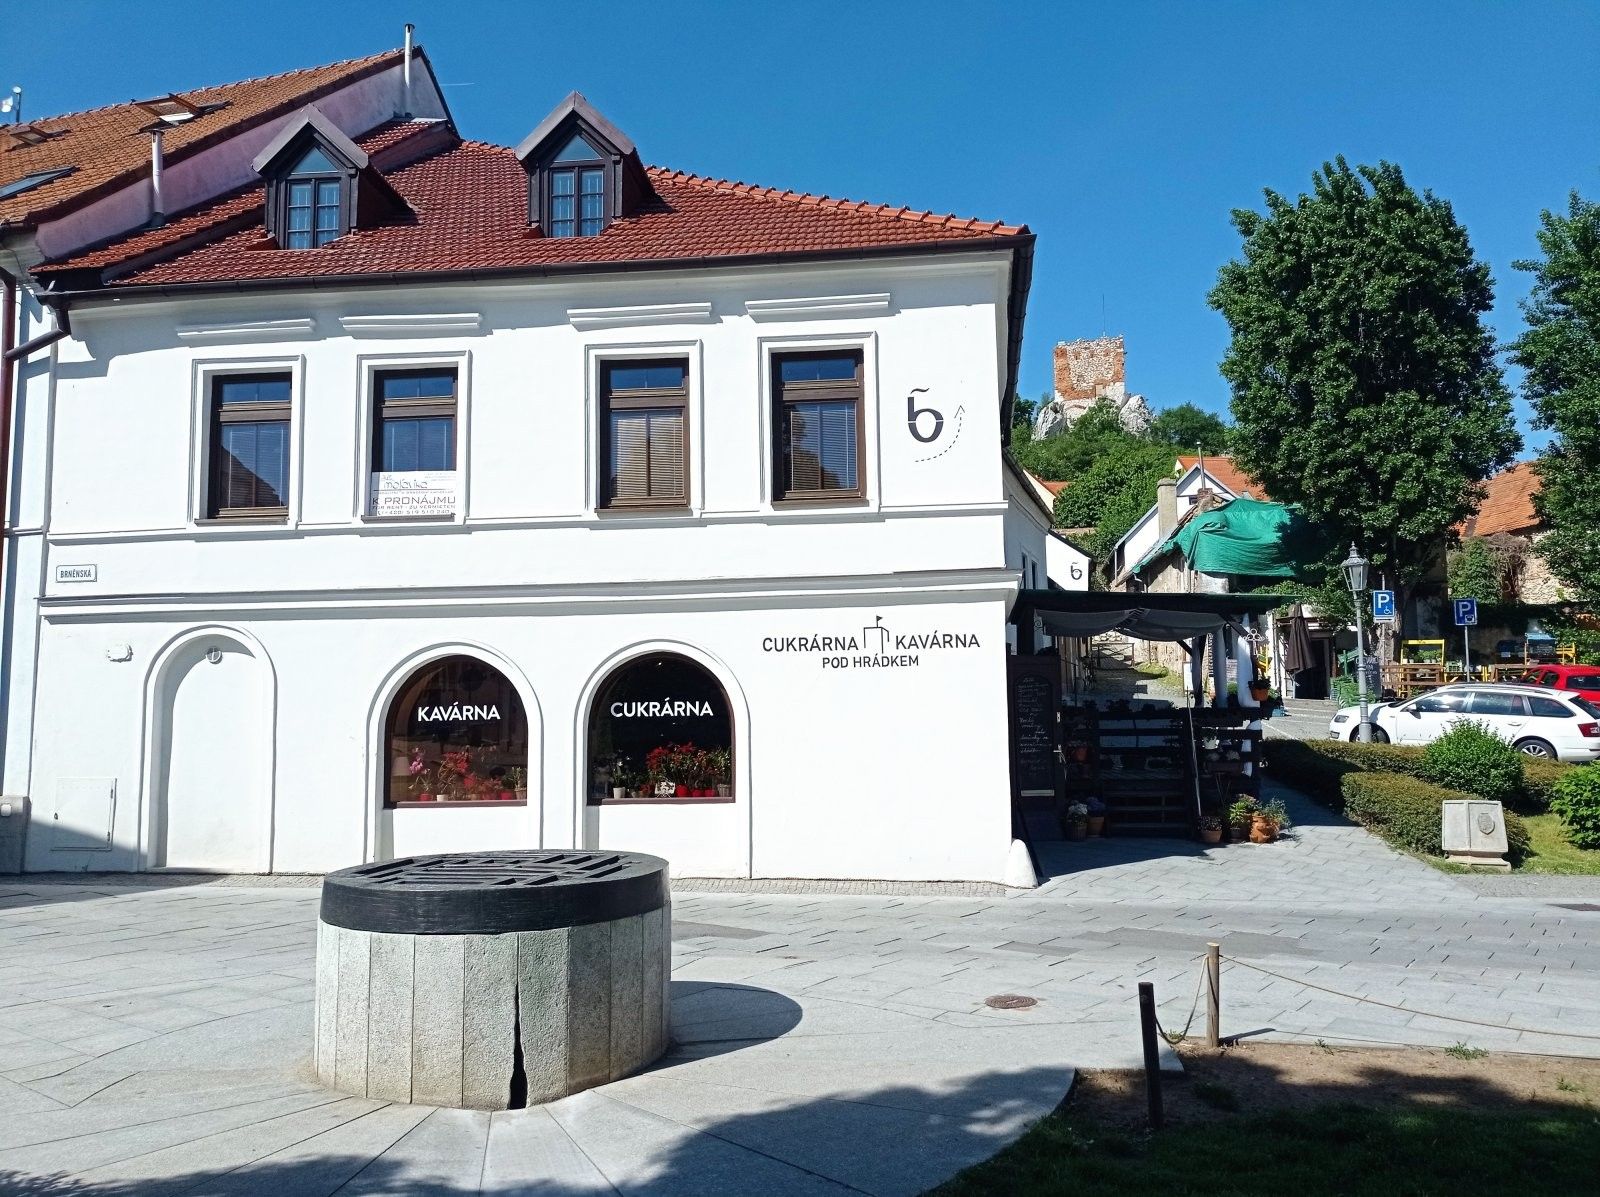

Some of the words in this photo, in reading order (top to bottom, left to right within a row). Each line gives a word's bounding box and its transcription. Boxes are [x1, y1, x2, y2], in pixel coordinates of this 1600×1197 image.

[384, 494, 456, 505] PRONÁJMU
[60, 568, 92, 579] BRNĚNSKÁ
[1377, 593, 1390, 609] P
[1459, 601, 1471, 617] P
[762, 634, 859, 652] CUKRÁRNA
[895, 630, 981, 650] KAVÁRNA
[822, 656, 849, 669] POD
[853, 653, 919, 668] HRÁDKEM
[417, 702, 501, 722] KAVÁRNA
[610, 697, 714, 718] CUKRÁRNA
